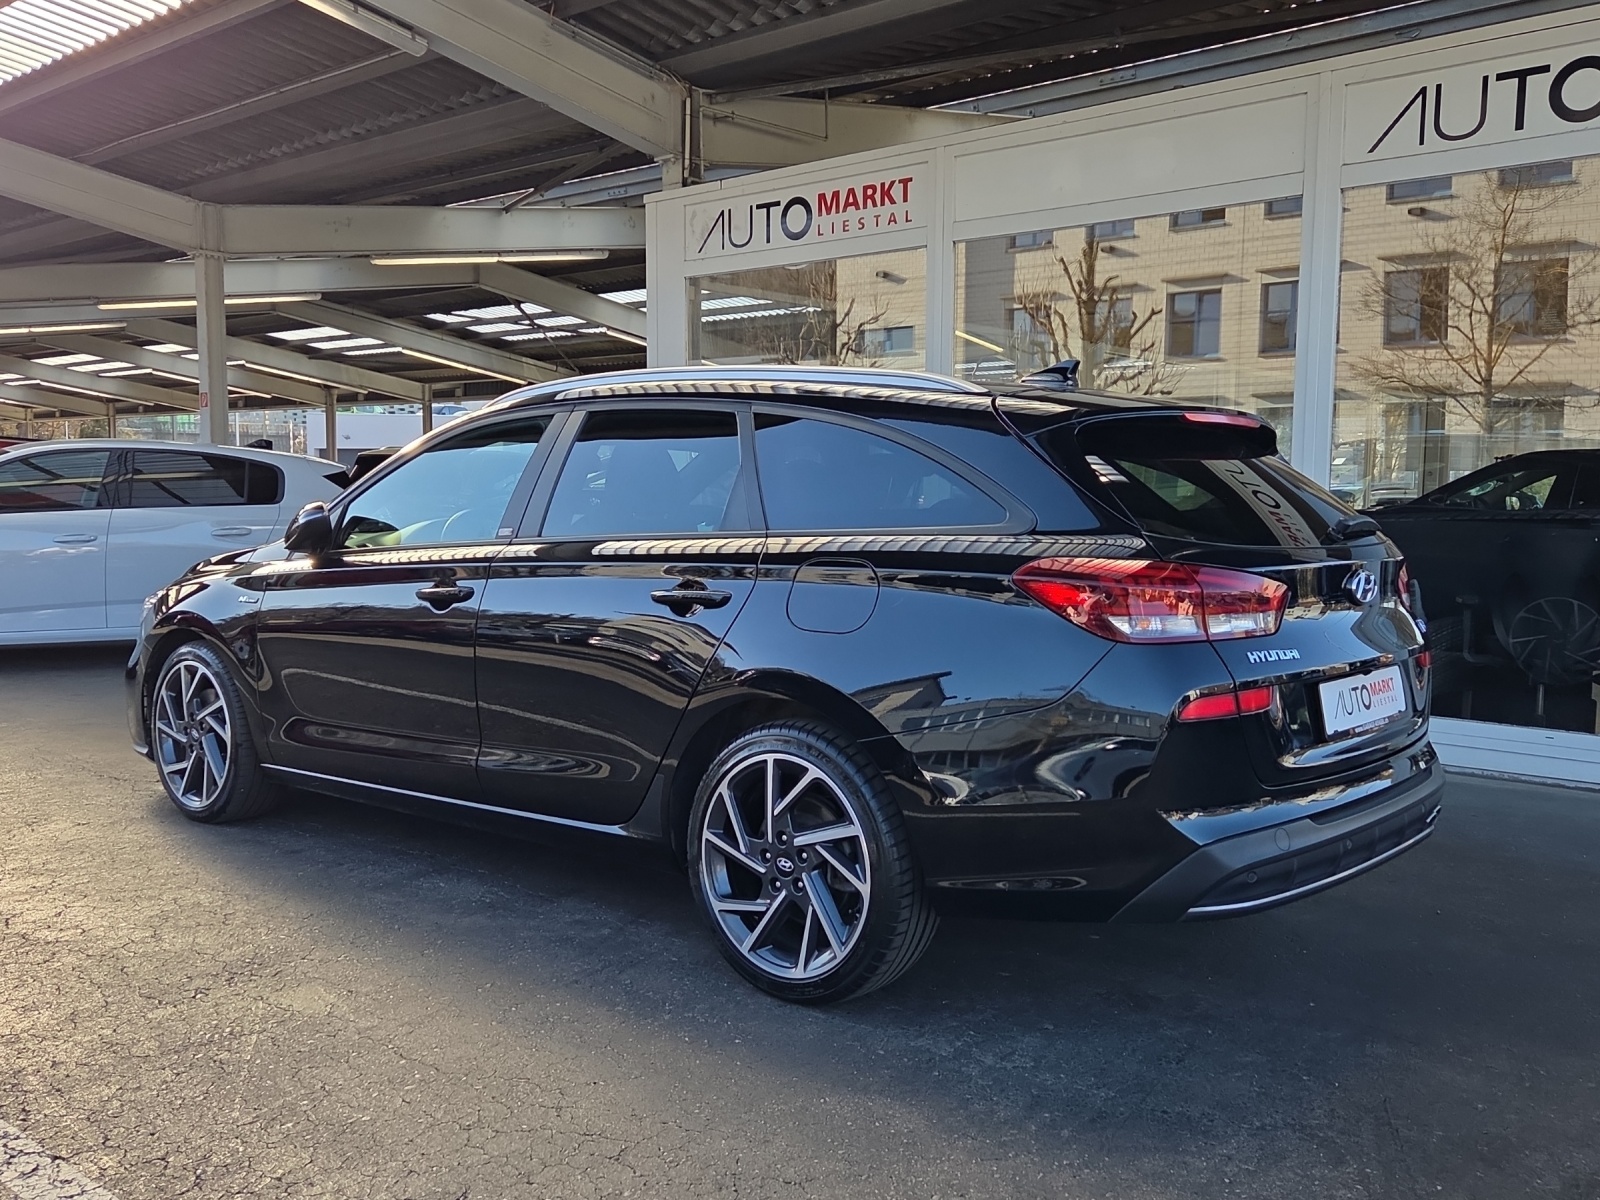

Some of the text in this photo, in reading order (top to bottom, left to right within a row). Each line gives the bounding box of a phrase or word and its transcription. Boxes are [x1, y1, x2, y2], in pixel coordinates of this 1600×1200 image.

[1367, 55, 1600, 153] AUTO
[698, 176, 913, 253] AUTO MARKT
[817, 210, 913, 237] LIESTAL
[1246, 649, 1300, 664] HYUNDAI
[1335, 677, 1395, 720] AUTO MARKT
[1373, 695, 1398, 708] LIESTAL
